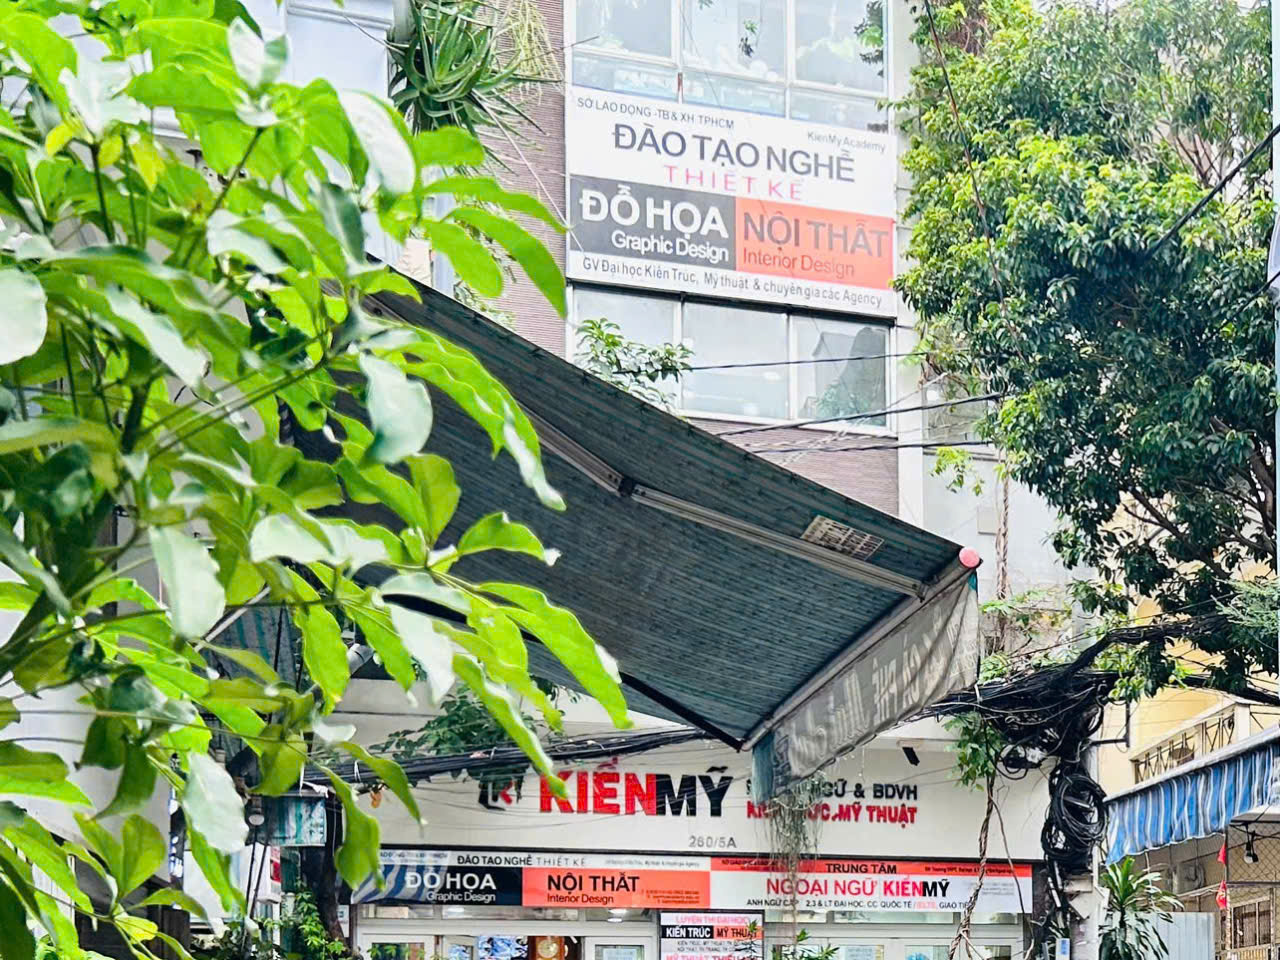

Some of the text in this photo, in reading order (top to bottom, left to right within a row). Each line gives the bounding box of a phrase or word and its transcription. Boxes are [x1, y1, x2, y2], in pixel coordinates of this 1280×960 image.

[596, 101, 618, 113] LAO
[681, 111, 695, 123] XH
[698, 114, 735, 129] TPHCM
[692, 134, 760, 168] TẠO
[646, 196, 729, 240] HỌA
[743, 210, 800, 252] NỘI
[611, 229, 729, 264] Graphic Design
[743, 247, 855, 280] Interior Design
[582, 257, 599, 271] GV
[622, 261, 643, 279] học
[752, 278, 761, 291] &
[842, 290, 883, 309] Agency
[853, 782, 866, 799] &
[872, 782, 919, 801] BDVH
[865, 803, 919, 830] THUẬT
[825, 862, 898, 874] TRUNG TÂM
[445, 872, 498, 894] HỌA
[547, 871, 583, 895] NỘI
[834, 877, 877, 897] NGỮ
[426, 890, 497, 904] Graphic Design
[547, 893, 615, 906] Interior Design
[666, 925, 711, 938] KIẾN TRÚC
[717, 926, 729, 938] MỸ
